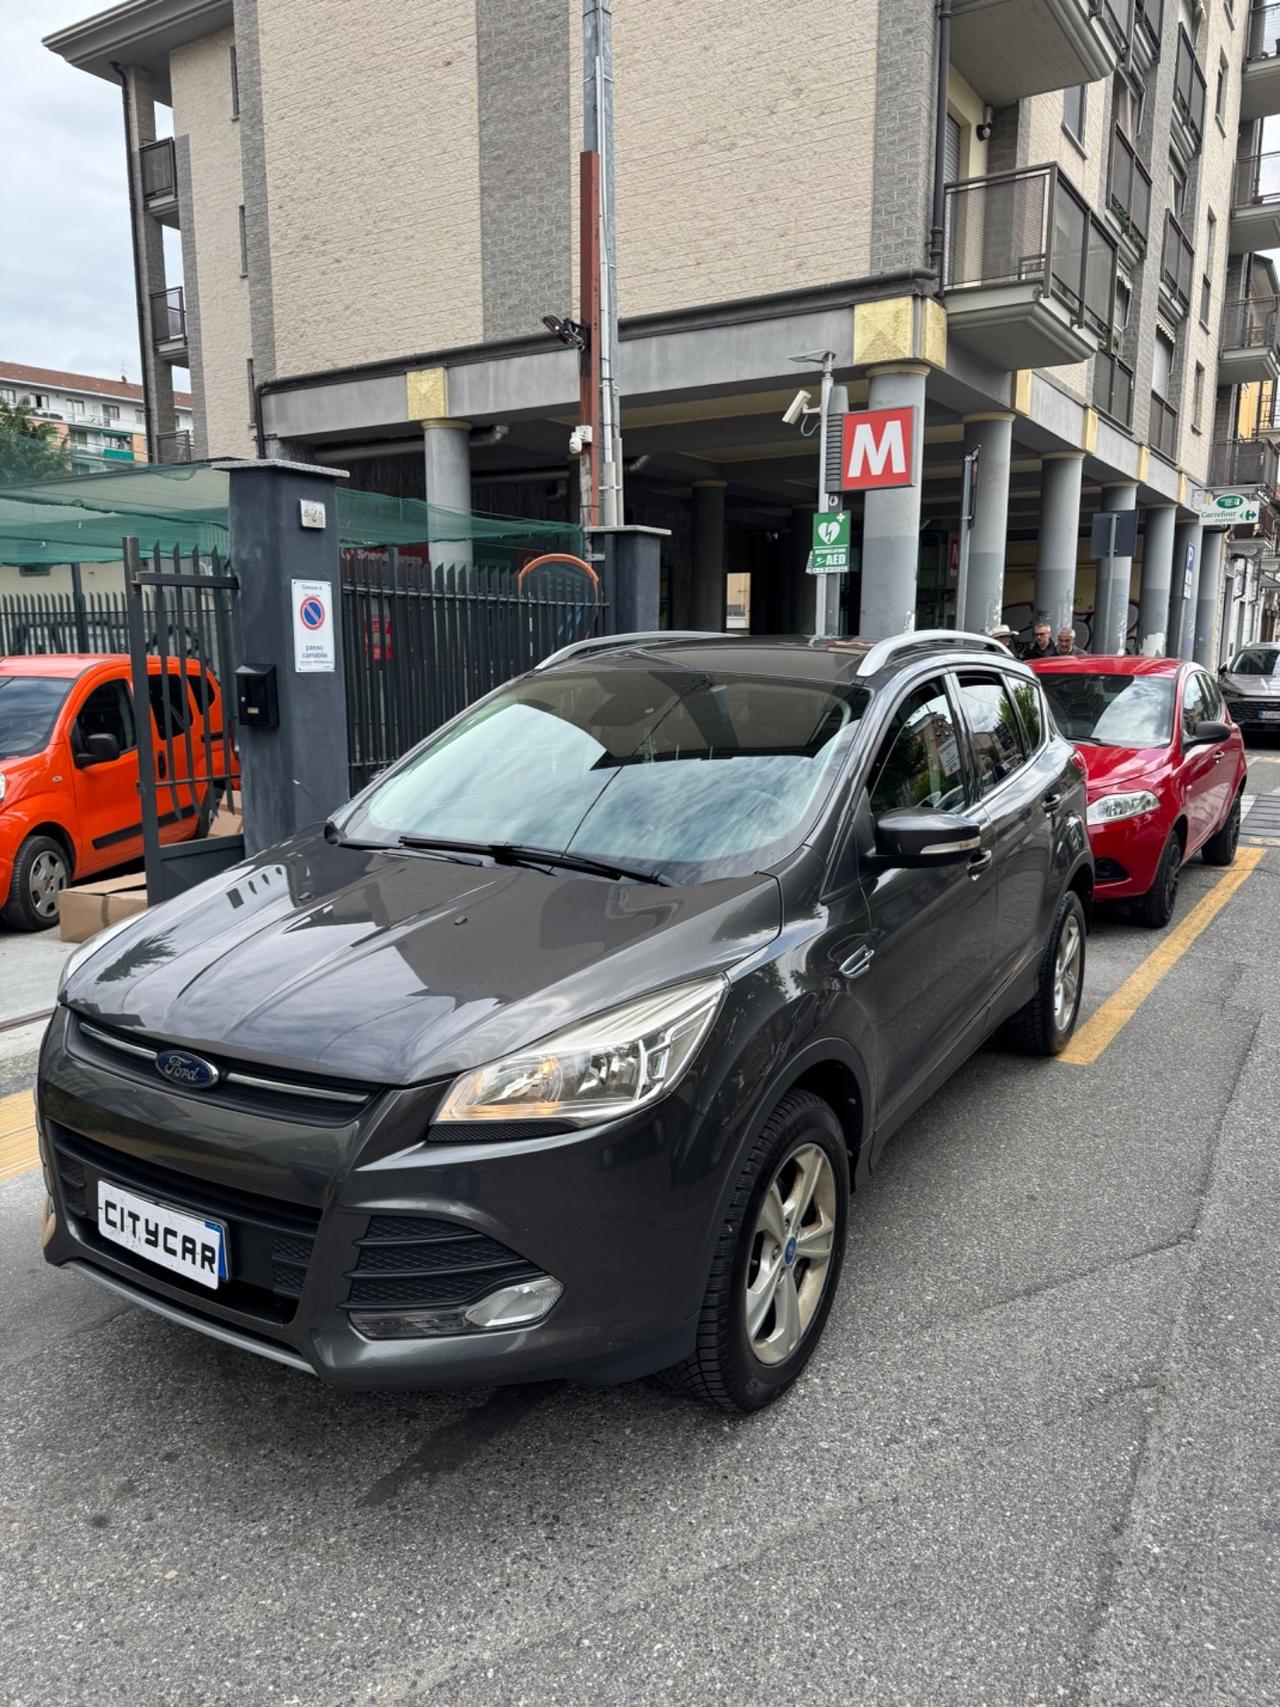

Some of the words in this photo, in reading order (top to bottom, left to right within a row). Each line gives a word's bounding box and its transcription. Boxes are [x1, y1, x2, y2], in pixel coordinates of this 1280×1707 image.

[848, 420, 906, 478] M
[1201, 510, 1236, 518] Carrefour
[825, 554, 846, 566] AED
[165, 1055, 200, 1081] Ford
[105, 1199, 216, 1274] CITYCAR
